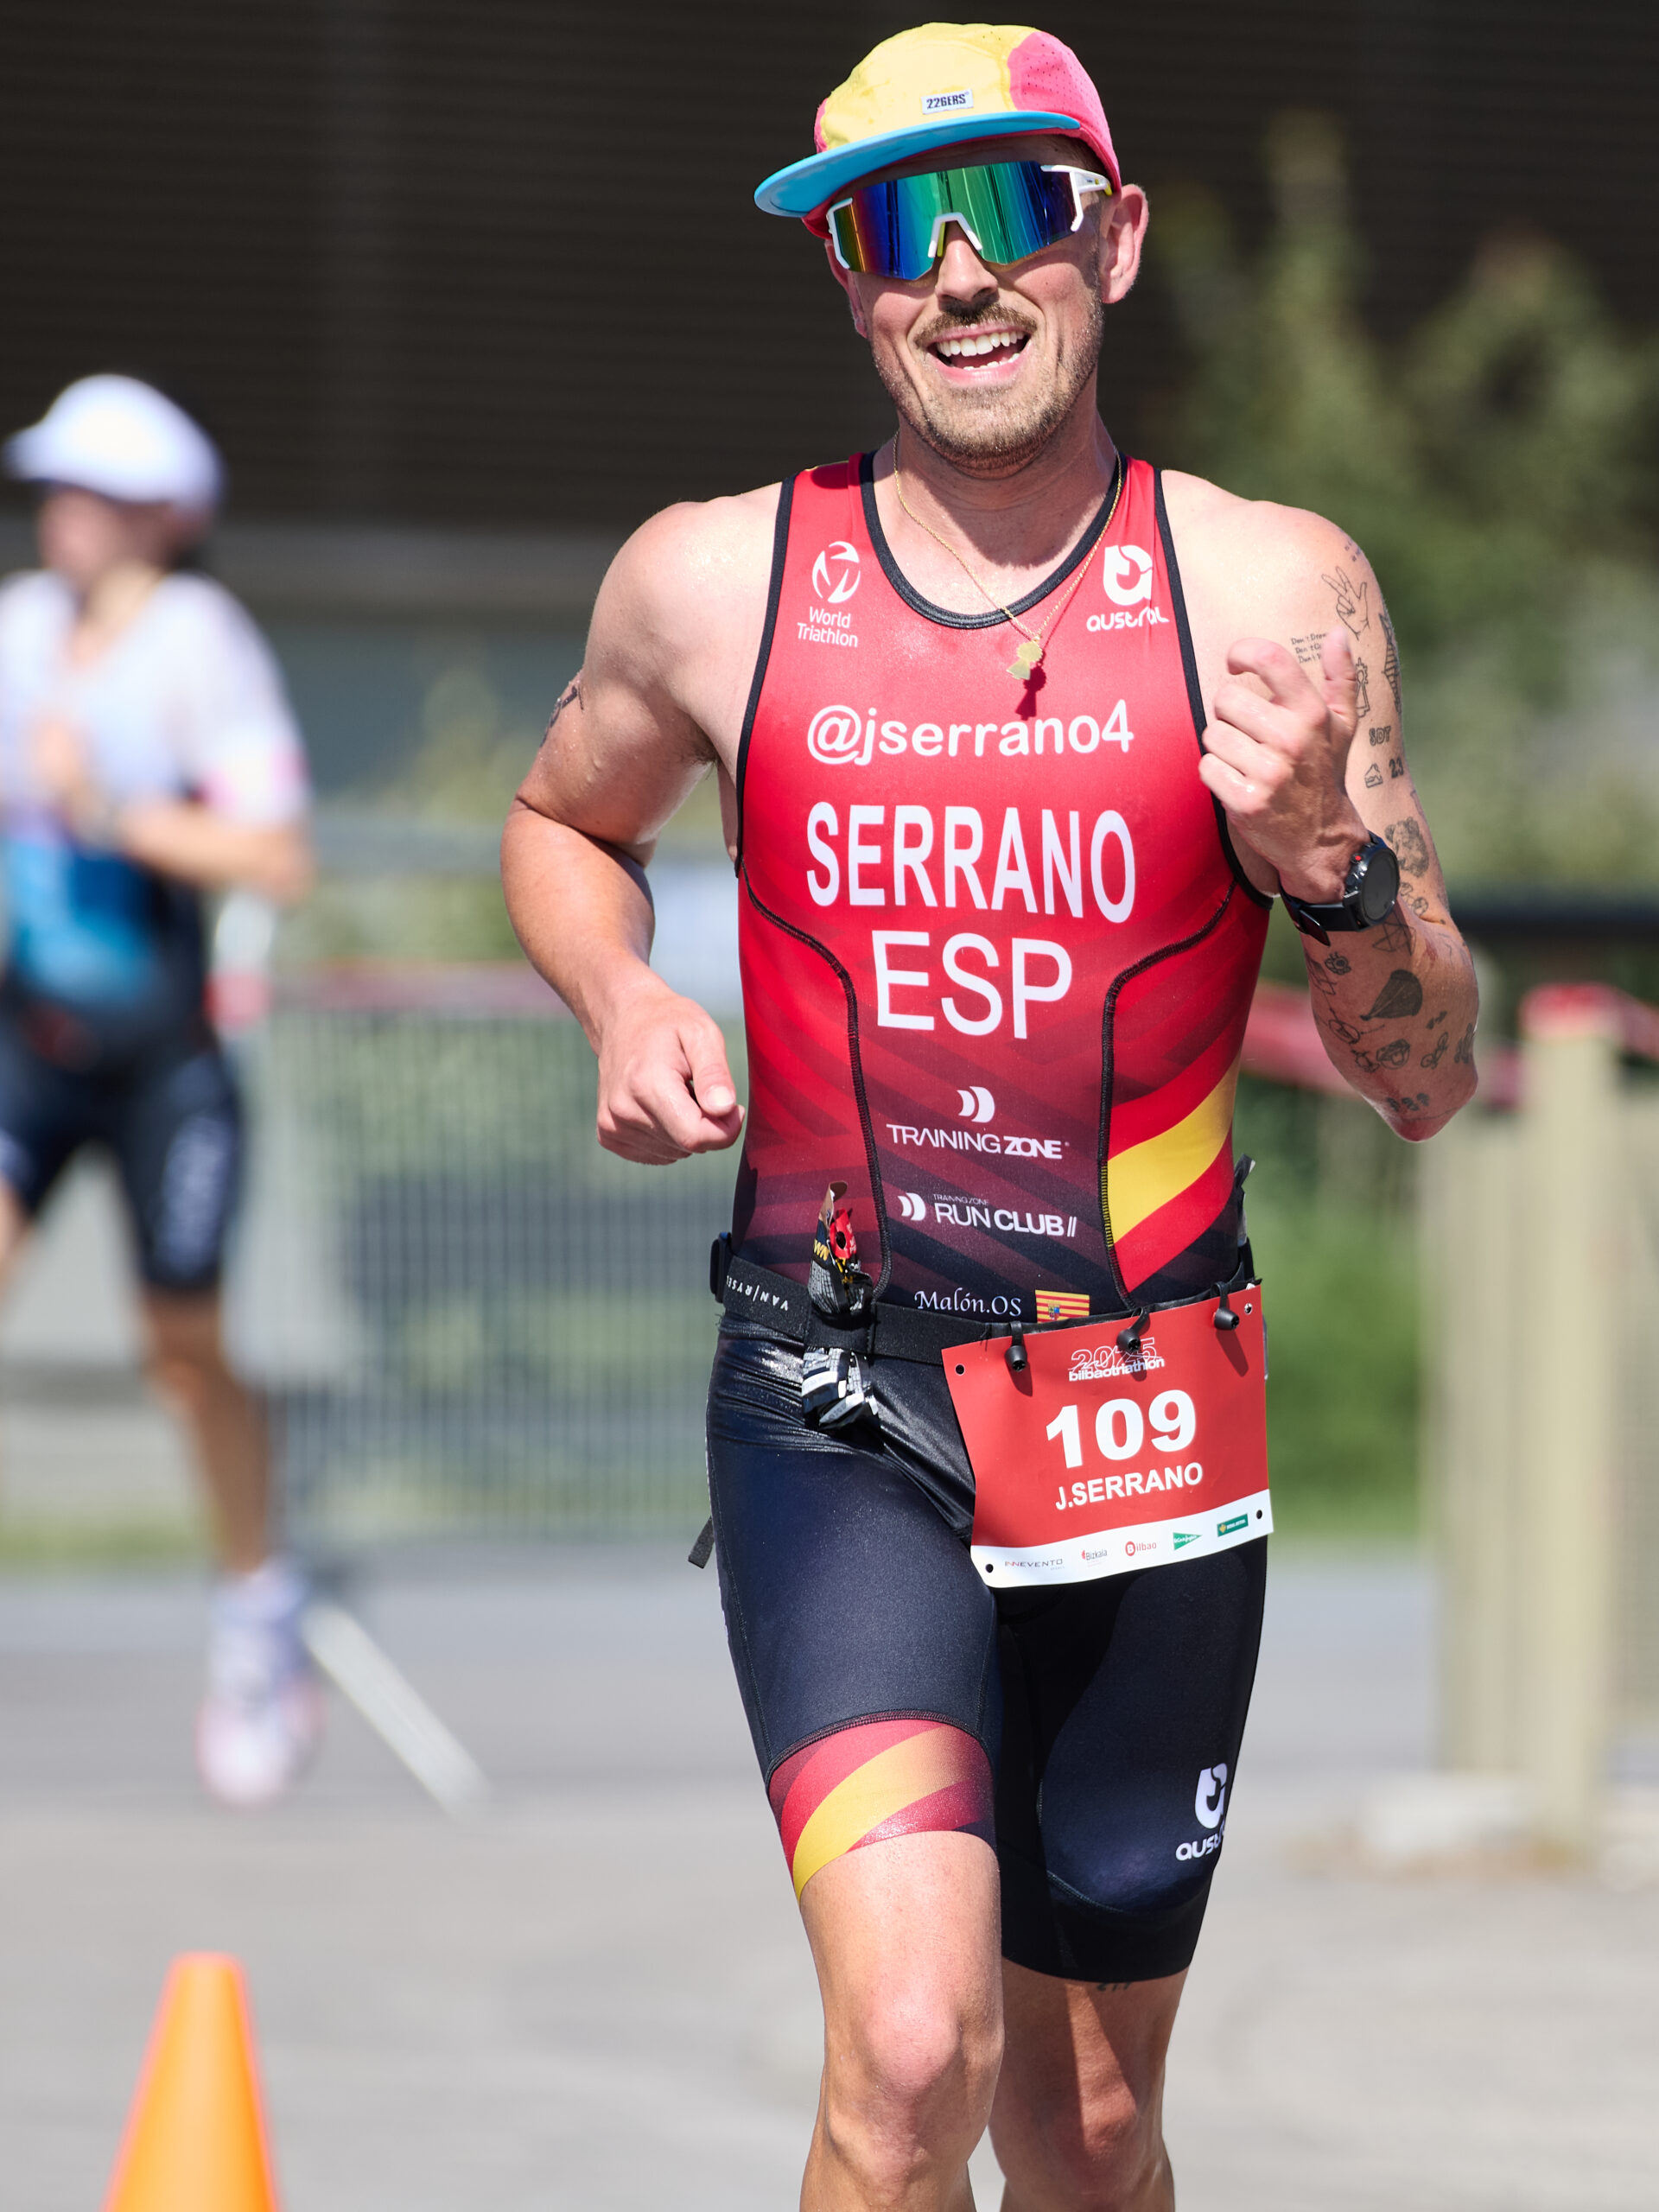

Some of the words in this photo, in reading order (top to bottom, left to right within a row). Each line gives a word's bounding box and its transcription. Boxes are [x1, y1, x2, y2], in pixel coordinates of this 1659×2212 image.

[926, 92, 966, 110] 226ERS
[809, 606, 851, 629] World
[1086, 606, 1170, 632] austral
[797, 621, 858, 648] Triathlon
[807, 698, 1135, 766] @jserrano4
[806, 801, 1136, 924] SERRANO
[871, 930, 1073, 1039] ESP
[886, 1123, 1001, 1154] TRAINING
[1003, 1135, 1063, 1160] ZONE
[934, 1202, 991, 1229] RUN
[994, 1209, 1065, 1236] CLUB
[914, 1287, 1021, 1317] Malón.OS
[1068, 1357, 1165, 1382] bilbaotriathlon
[1046, 1389, 1197, 1469] 109
[1055, 1462, 1204, 1510] J.SERRANO
[1125, 1541, 1157, 1557] Bilbao
